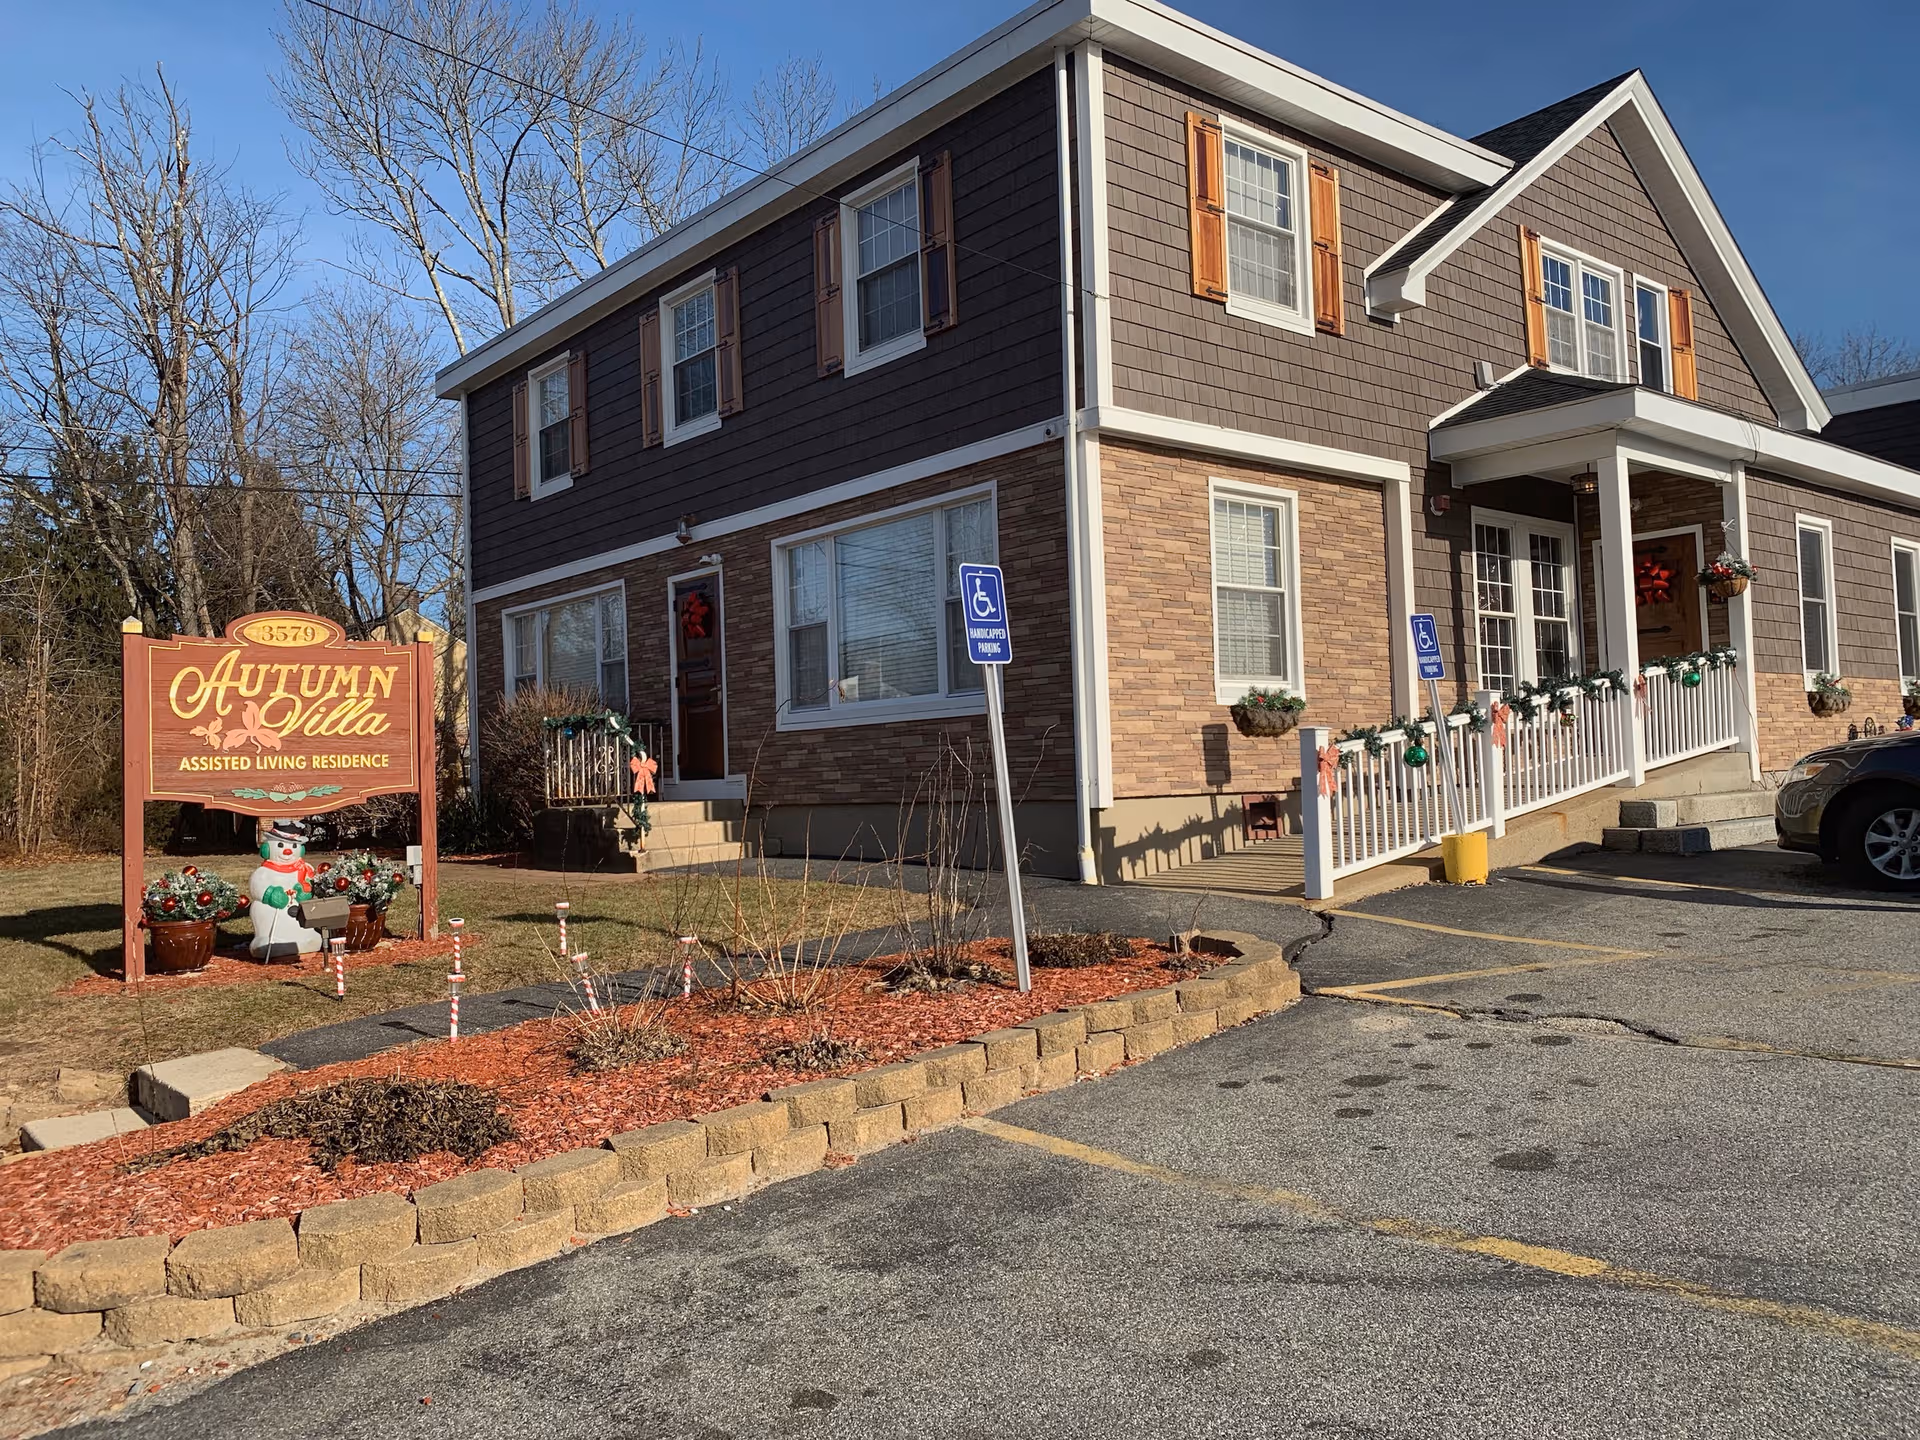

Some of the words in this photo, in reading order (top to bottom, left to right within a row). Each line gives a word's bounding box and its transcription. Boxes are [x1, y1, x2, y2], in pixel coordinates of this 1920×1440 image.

[261, 625, 316, 642] 3579
[969, 627, 1007, 640] HANDICAPPED
[978, 642, 1002, 654] PARKING
[169, 649, 398, 720] AUTUMN
[258, 694, 392, 738] Villa
[179, 756, 251, 772] ASSISTED
[256, 756, 307, 771] LIVING
[312, 754, 389, 769] RESIDENCE
